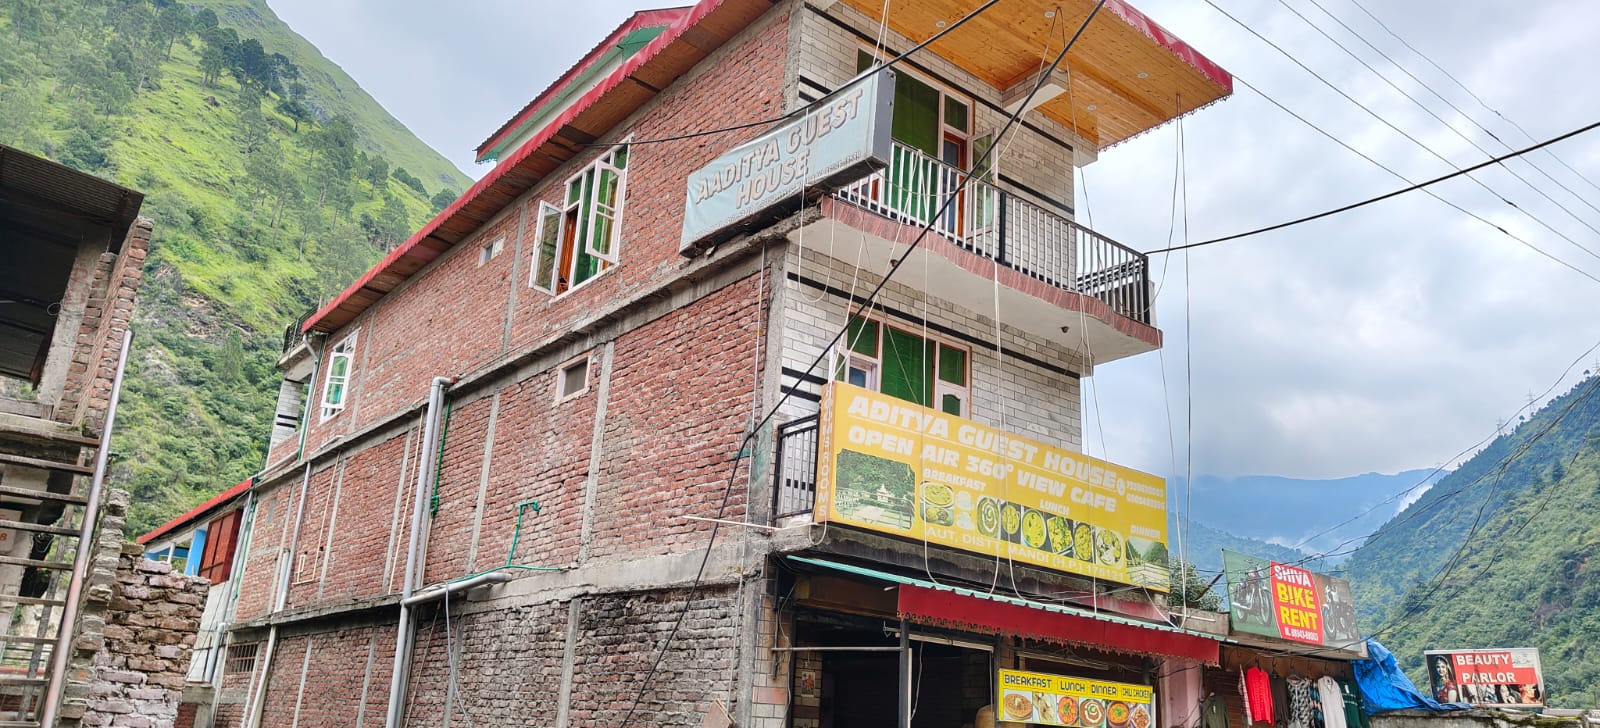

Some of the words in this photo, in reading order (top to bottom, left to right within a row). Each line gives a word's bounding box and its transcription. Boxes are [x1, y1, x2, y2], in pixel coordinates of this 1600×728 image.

[696, 138, 780, 204] AADITYA
[786, 88, 863, 154] GUEST
[735, 149, 811, 209] HOUSE
[848, 394, 949, 439] ADITYA
[958, 424, 1038, 463] GUEST
[1043, 451, 1117, 490] HOUSE
[848, 425, 914, 457] OPEN
[920, 443, 960, 469] AIR
[1017, 467, 1067, 498] VIEW
[1070, 486, 1117, 513] CAFE
[923, 468, 986, 491] BREAKFAST
[1039, 499, 1070, 515] LUNCH
[1008, 544, 1049, 564] MANDI
[1274, 565, 1311, 588] SHIVA
[1276, 582, 1316, 610] BIKE
[1279, 605, 1318, 631] RENT
[1456, 654, 1509, 665] BEAUTY
[1004, 673, 1052, 688] BREAKFAST
[1060, 680, 1085, 692] LUNCH
[1091, 683, 1117, 696] DINNER
[1462, 672, 1516, 683] PARLOR
